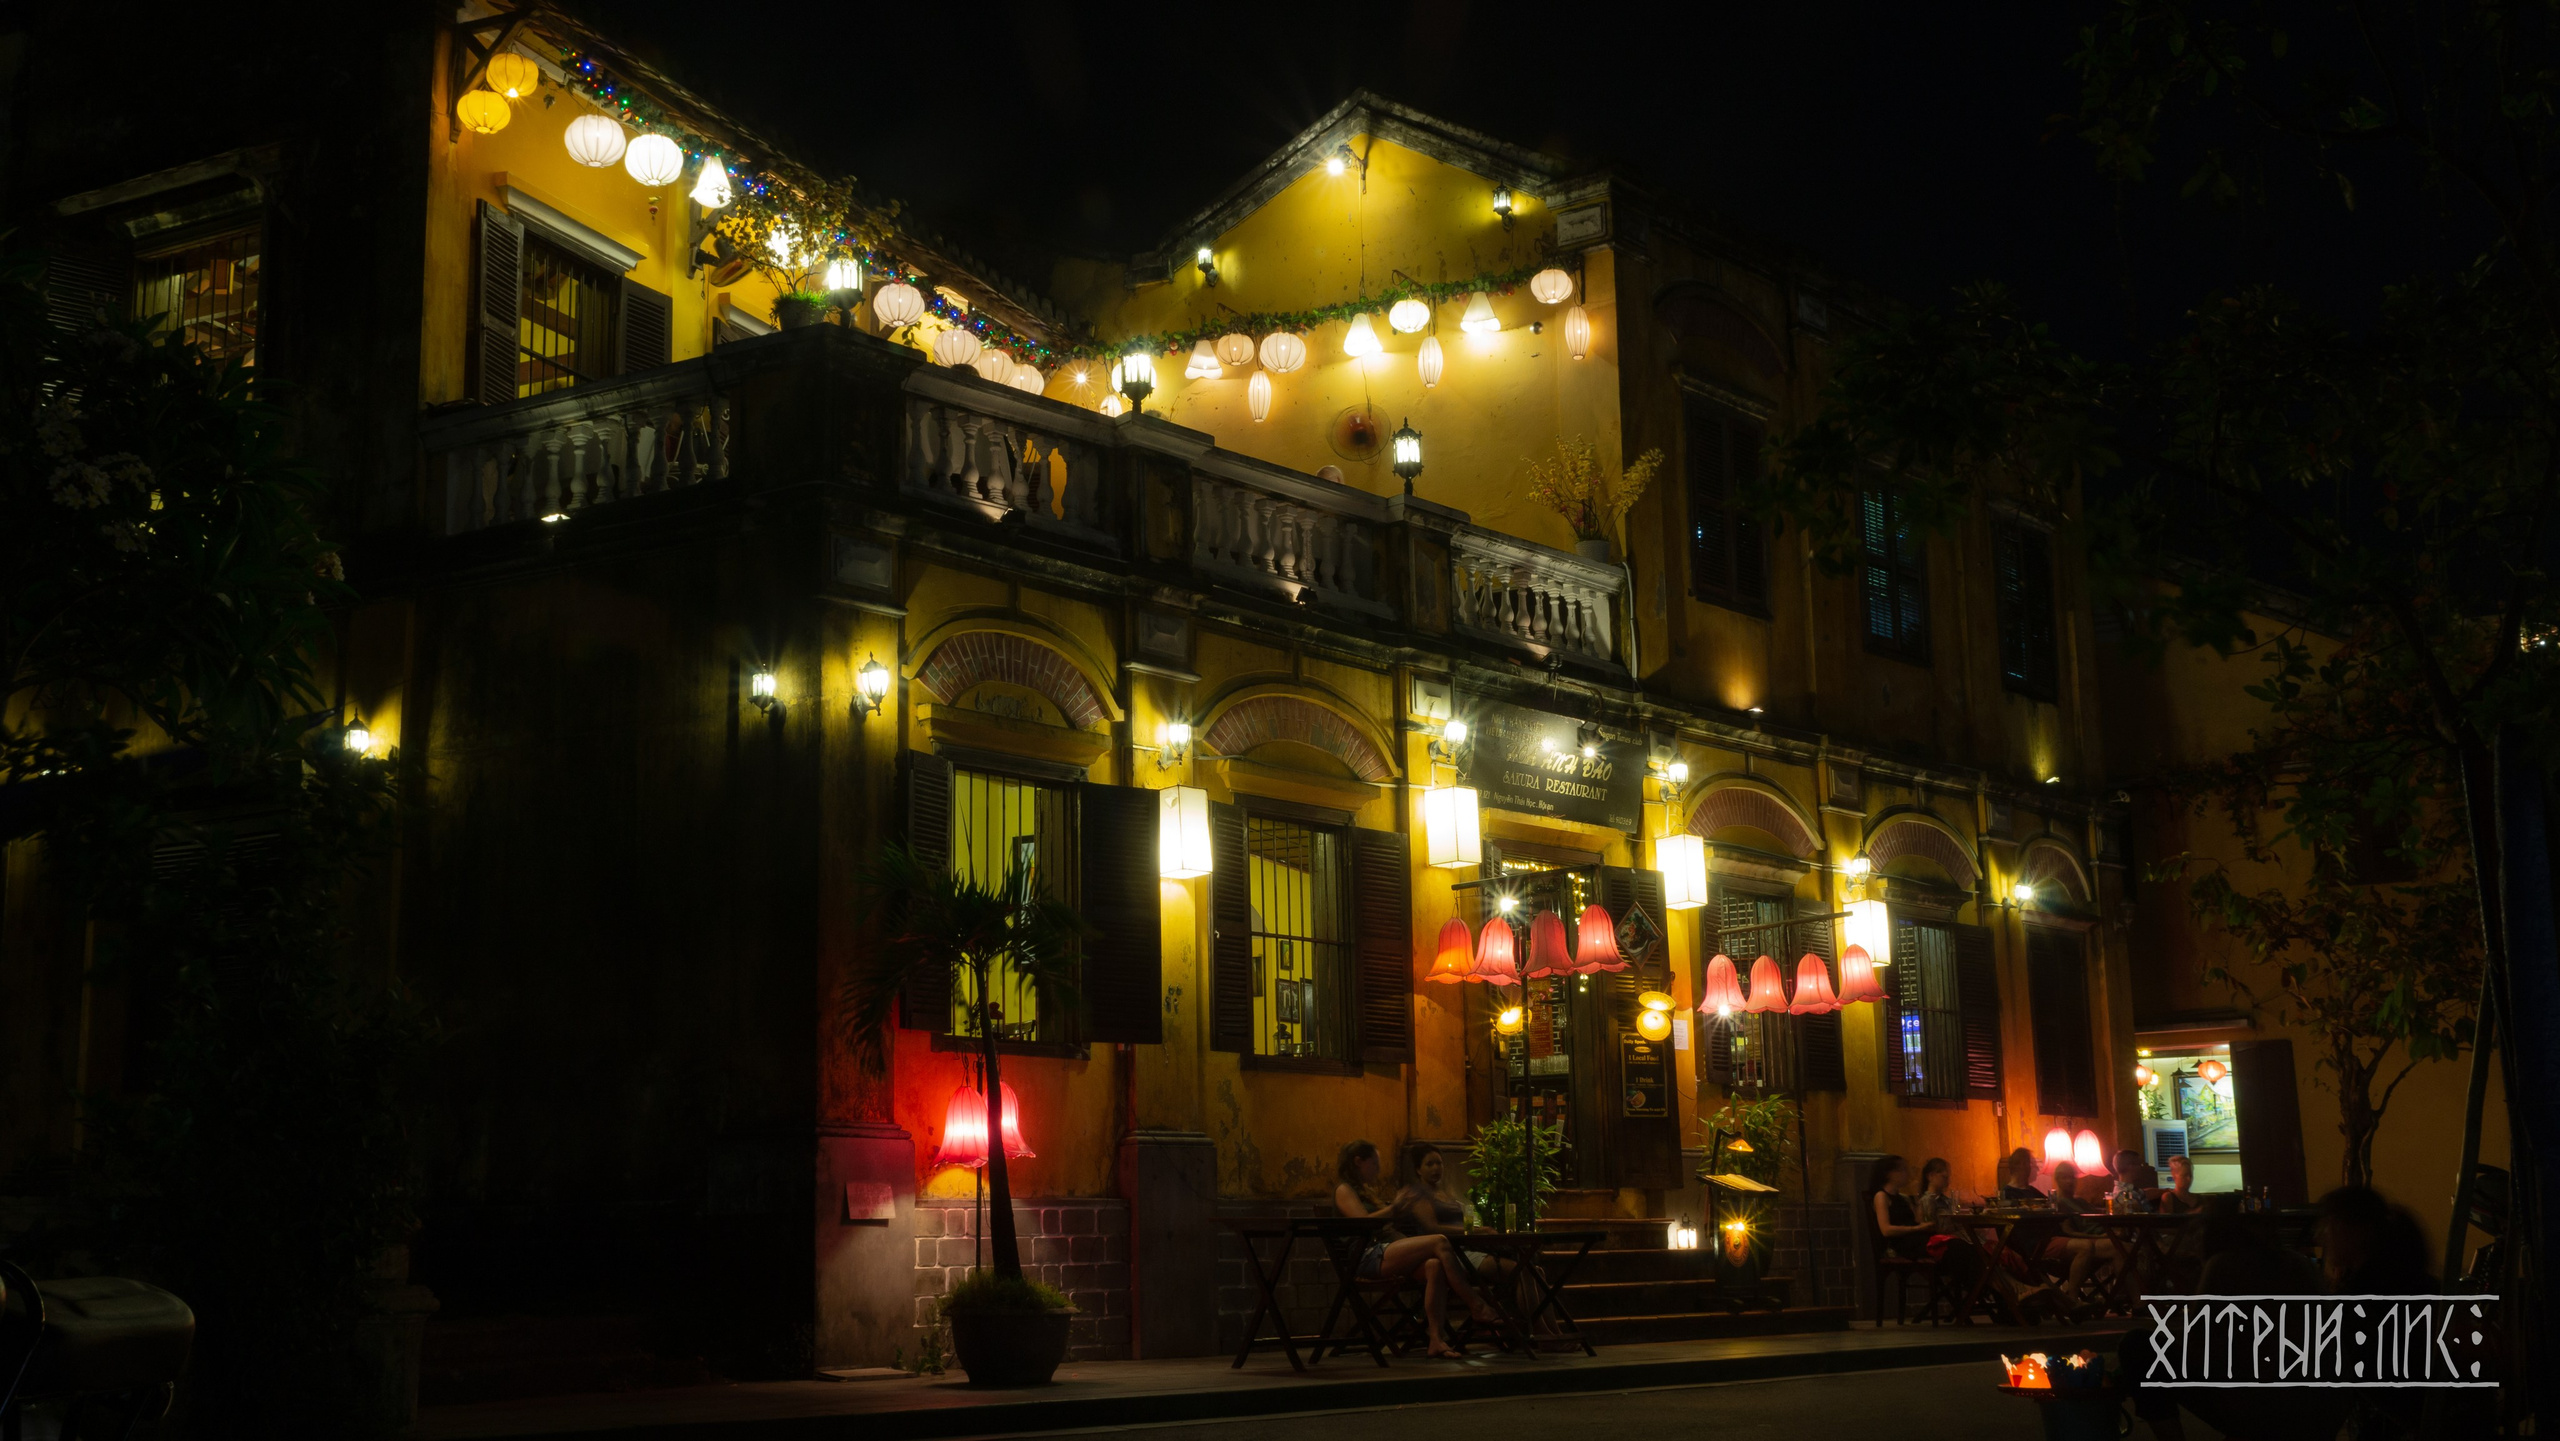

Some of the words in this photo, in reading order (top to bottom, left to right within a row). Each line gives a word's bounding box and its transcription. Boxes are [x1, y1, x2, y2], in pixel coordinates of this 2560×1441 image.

[1541, 750, 1579, 775] ANH
[1503, 770, 1540, 790] SAKURA
[1545, 778, 1608, 801] RESTAURANT
